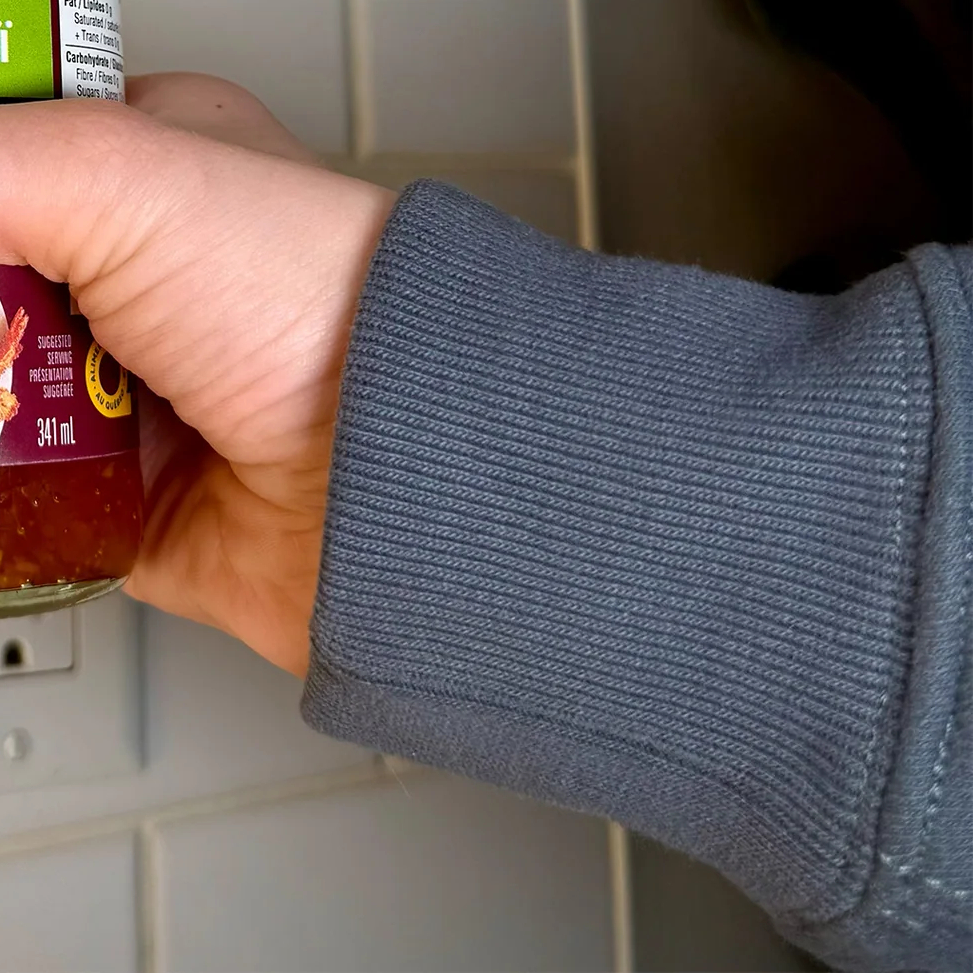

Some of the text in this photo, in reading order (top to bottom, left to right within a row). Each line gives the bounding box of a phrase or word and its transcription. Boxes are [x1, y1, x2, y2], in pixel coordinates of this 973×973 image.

[74, 12, 104, 28] Saturated
[81, 29, 100, 43] Trans
[66, 50, 109, 68] Carbohydrate
[76, 68, 94, 82] Fibre
[76, 85, 100, 99] Sugars
[37, 334, 72, 349] SUGGESTED
[47, 350, 73, 365] SERVING
[29, 367, 74, 383] PRÉSENTATION
[42, 383, 74, 399] SUGGÉRÉE
[95, 392, 105, 406] AU
[37, 415, 76, 447] 341 mL
